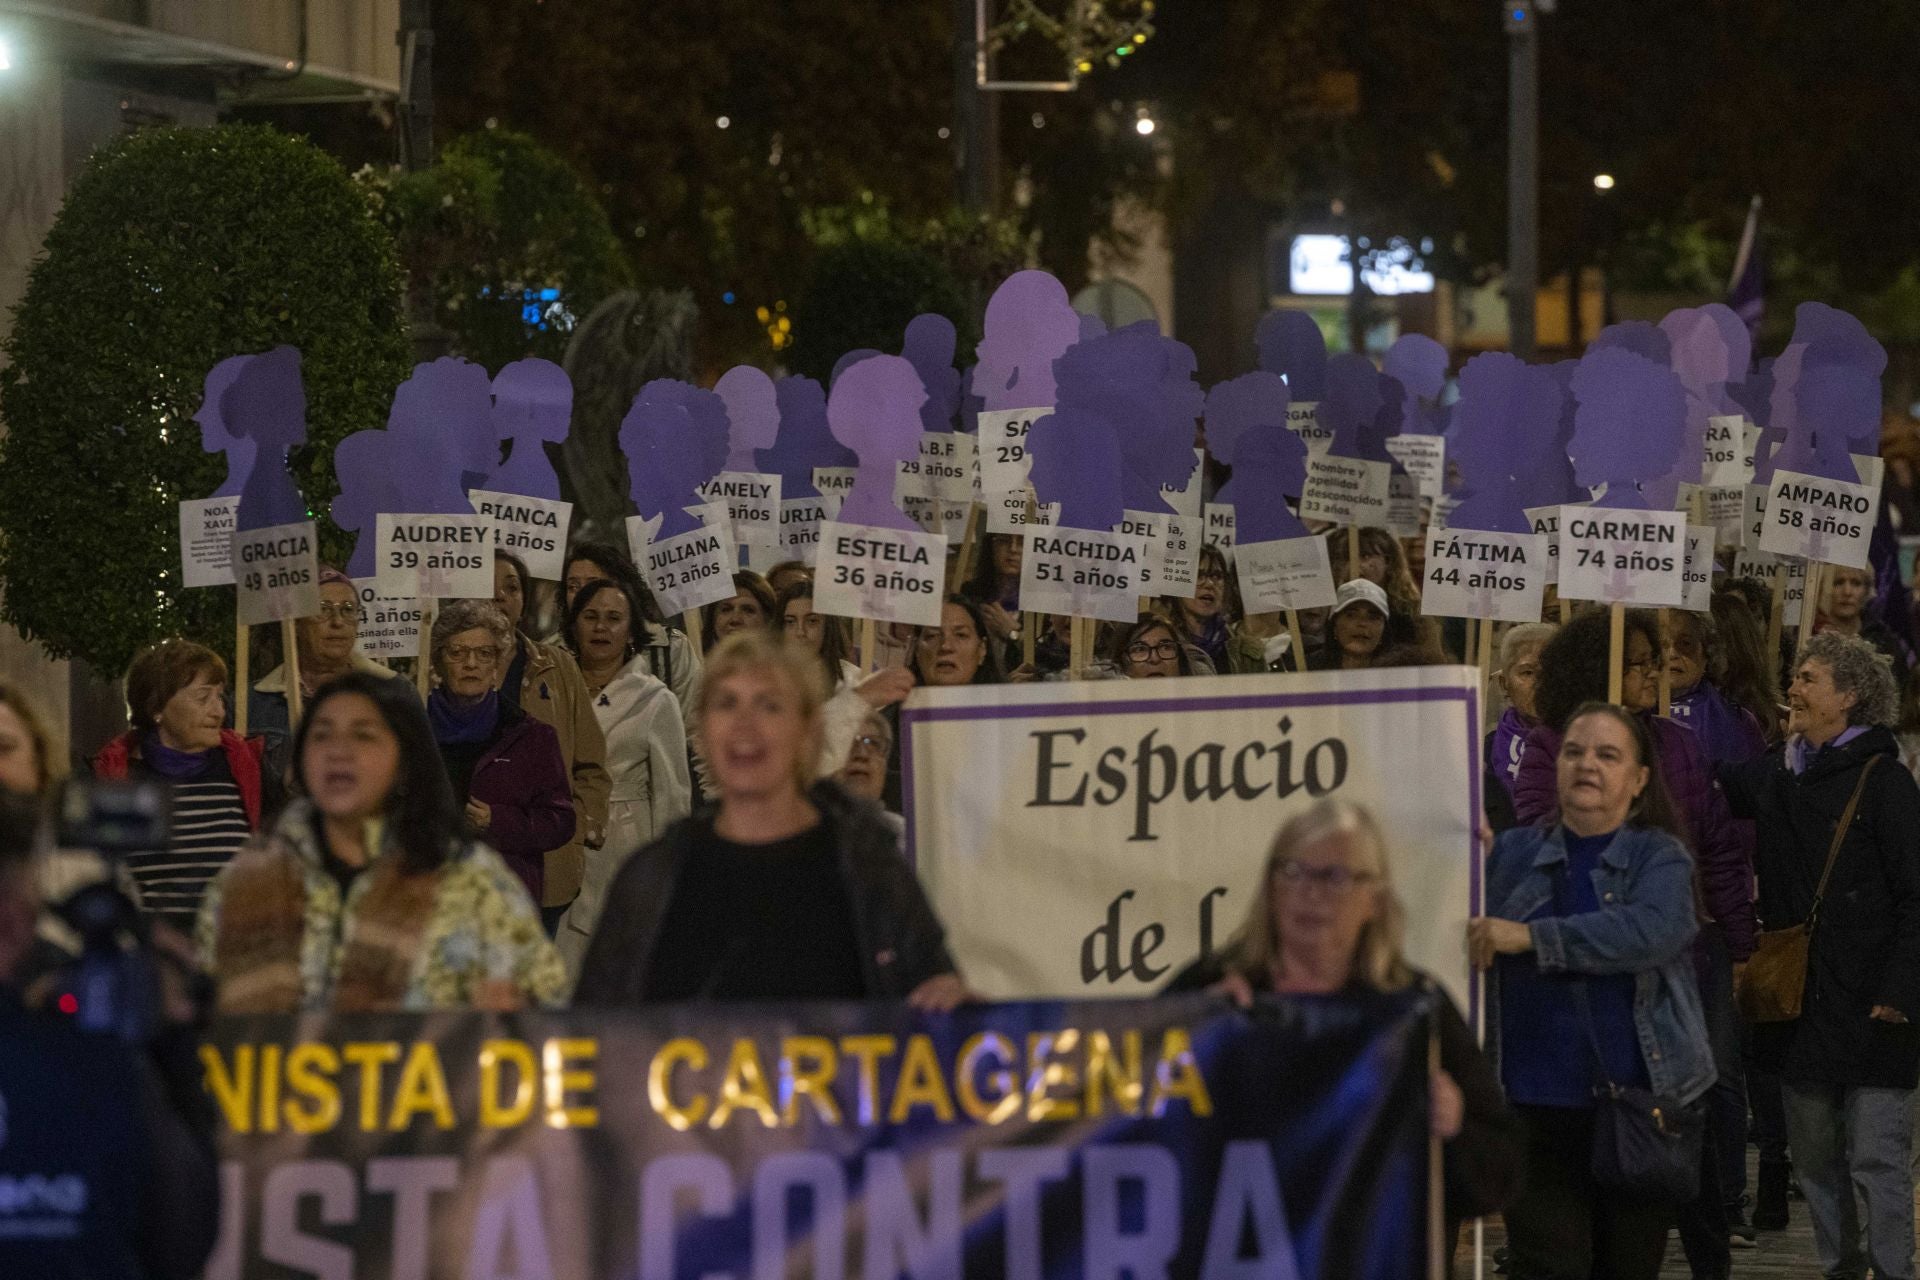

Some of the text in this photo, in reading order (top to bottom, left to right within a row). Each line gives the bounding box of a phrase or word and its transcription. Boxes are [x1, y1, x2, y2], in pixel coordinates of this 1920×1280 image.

[997, 446, 1024, 463] 29
[901, 461, 963, 477] 29 años
[1311, 462, 1365, 479] Nombre y
[699, 482, 772, 499] YANELY
[1308, 476, 1358, 490] apellidos
[1304, 501, 1350, 515] 33 años
[1307, 489, 1383, 506] desconocidos
[1777, 483, 1869, 514] AMPARO
[204, 506, 229, 517] NOA
[480, 502, 558, 528] BIANCA
[1778, 508, 1861, 538] 58 años
[391, 526, 489, 543] AUDREY
[506, 531, 555, 551] años
[1209, 534, 1231, 548] 74
[1570, 520, 1675, 543] CARMEN
[242, 537, 310, 563] GRACIA
[390, 551, 482, 569] 39 años
[649, 535, 720, 570] JULIANA
[836, 537, 929, 565] ESTELA
[1033, 536, 1136, 563] RACHIDA
[1433, 535, 1526, 564] FÁTIMA
[1577, 550, 1674, 572] 74 años
[245, 567, 310, 591] 49 años
[657, 561, 720, 591] 32 años
[833, 565, 934, 594] 36 años
[1035, 563, 1128, 589] 51 años
[1430, 567, 1525, 590] 44 años
[1739, 562, 1804, 578] MANEL
[375, 608, 421, 623] años
[380, 640, 405, 650] hijo.
[1025, 715, 1350, 841] Espacio
[1079, 889, 1172, 984] de
[198, 1028, 1213, 1135] NISTA DE CARTAGENA
[640, 1139, 1301, 1280] CONTRA
